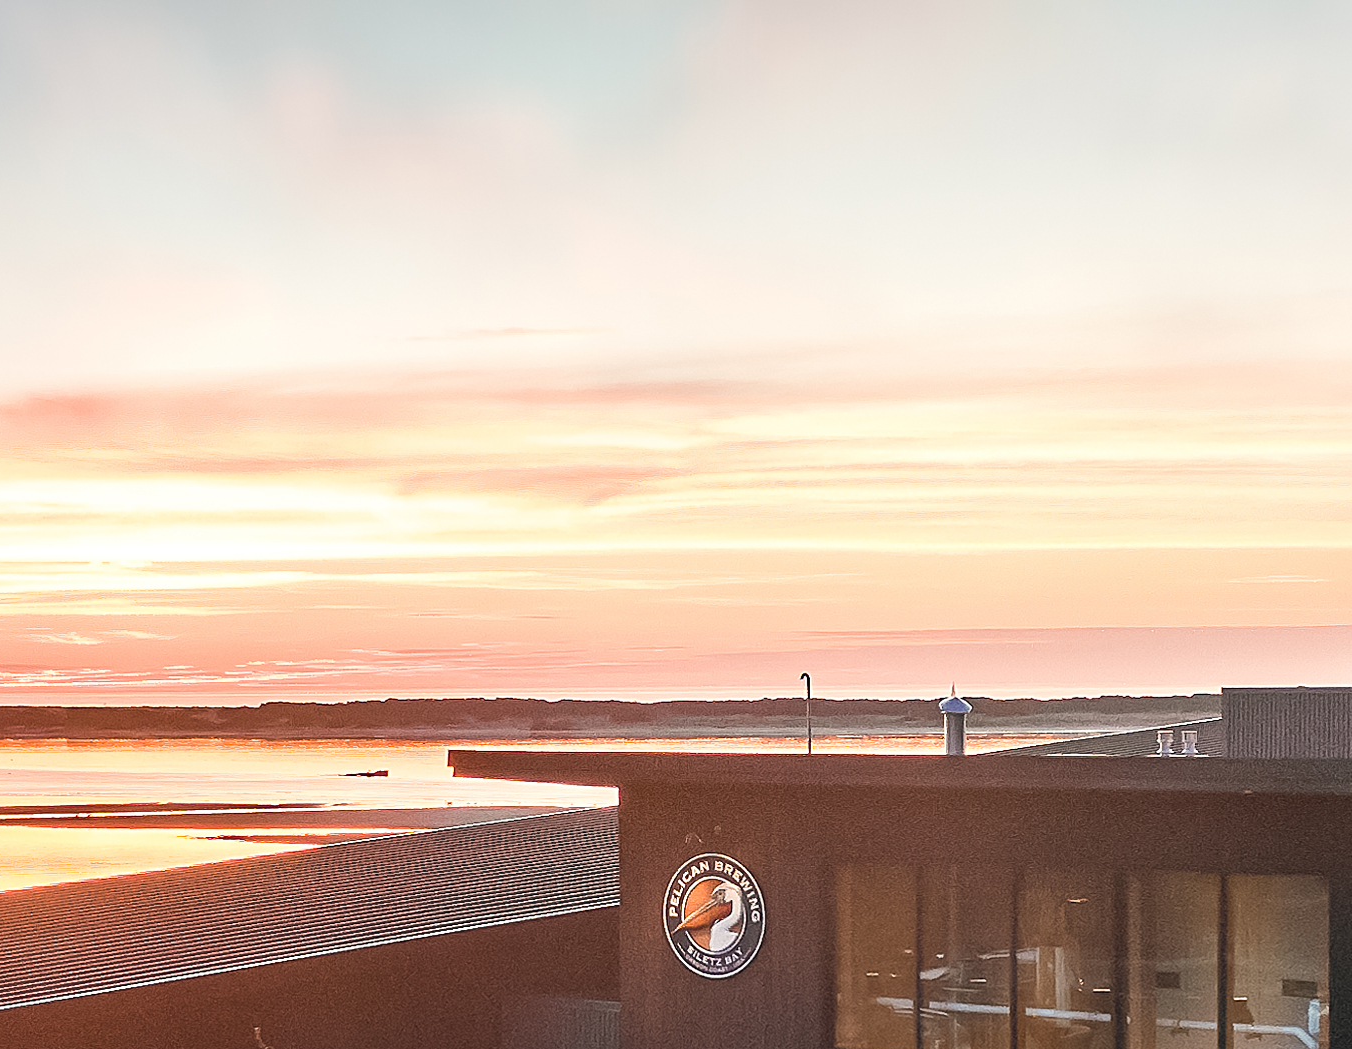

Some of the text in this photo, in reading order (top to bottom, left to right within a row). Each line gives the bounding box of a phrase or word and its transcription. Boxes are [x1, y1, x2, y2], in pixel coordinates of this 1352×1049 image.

[669, 861, 761, 923] PELICAN BREWING
[725, 947, 743, 964] BAY
